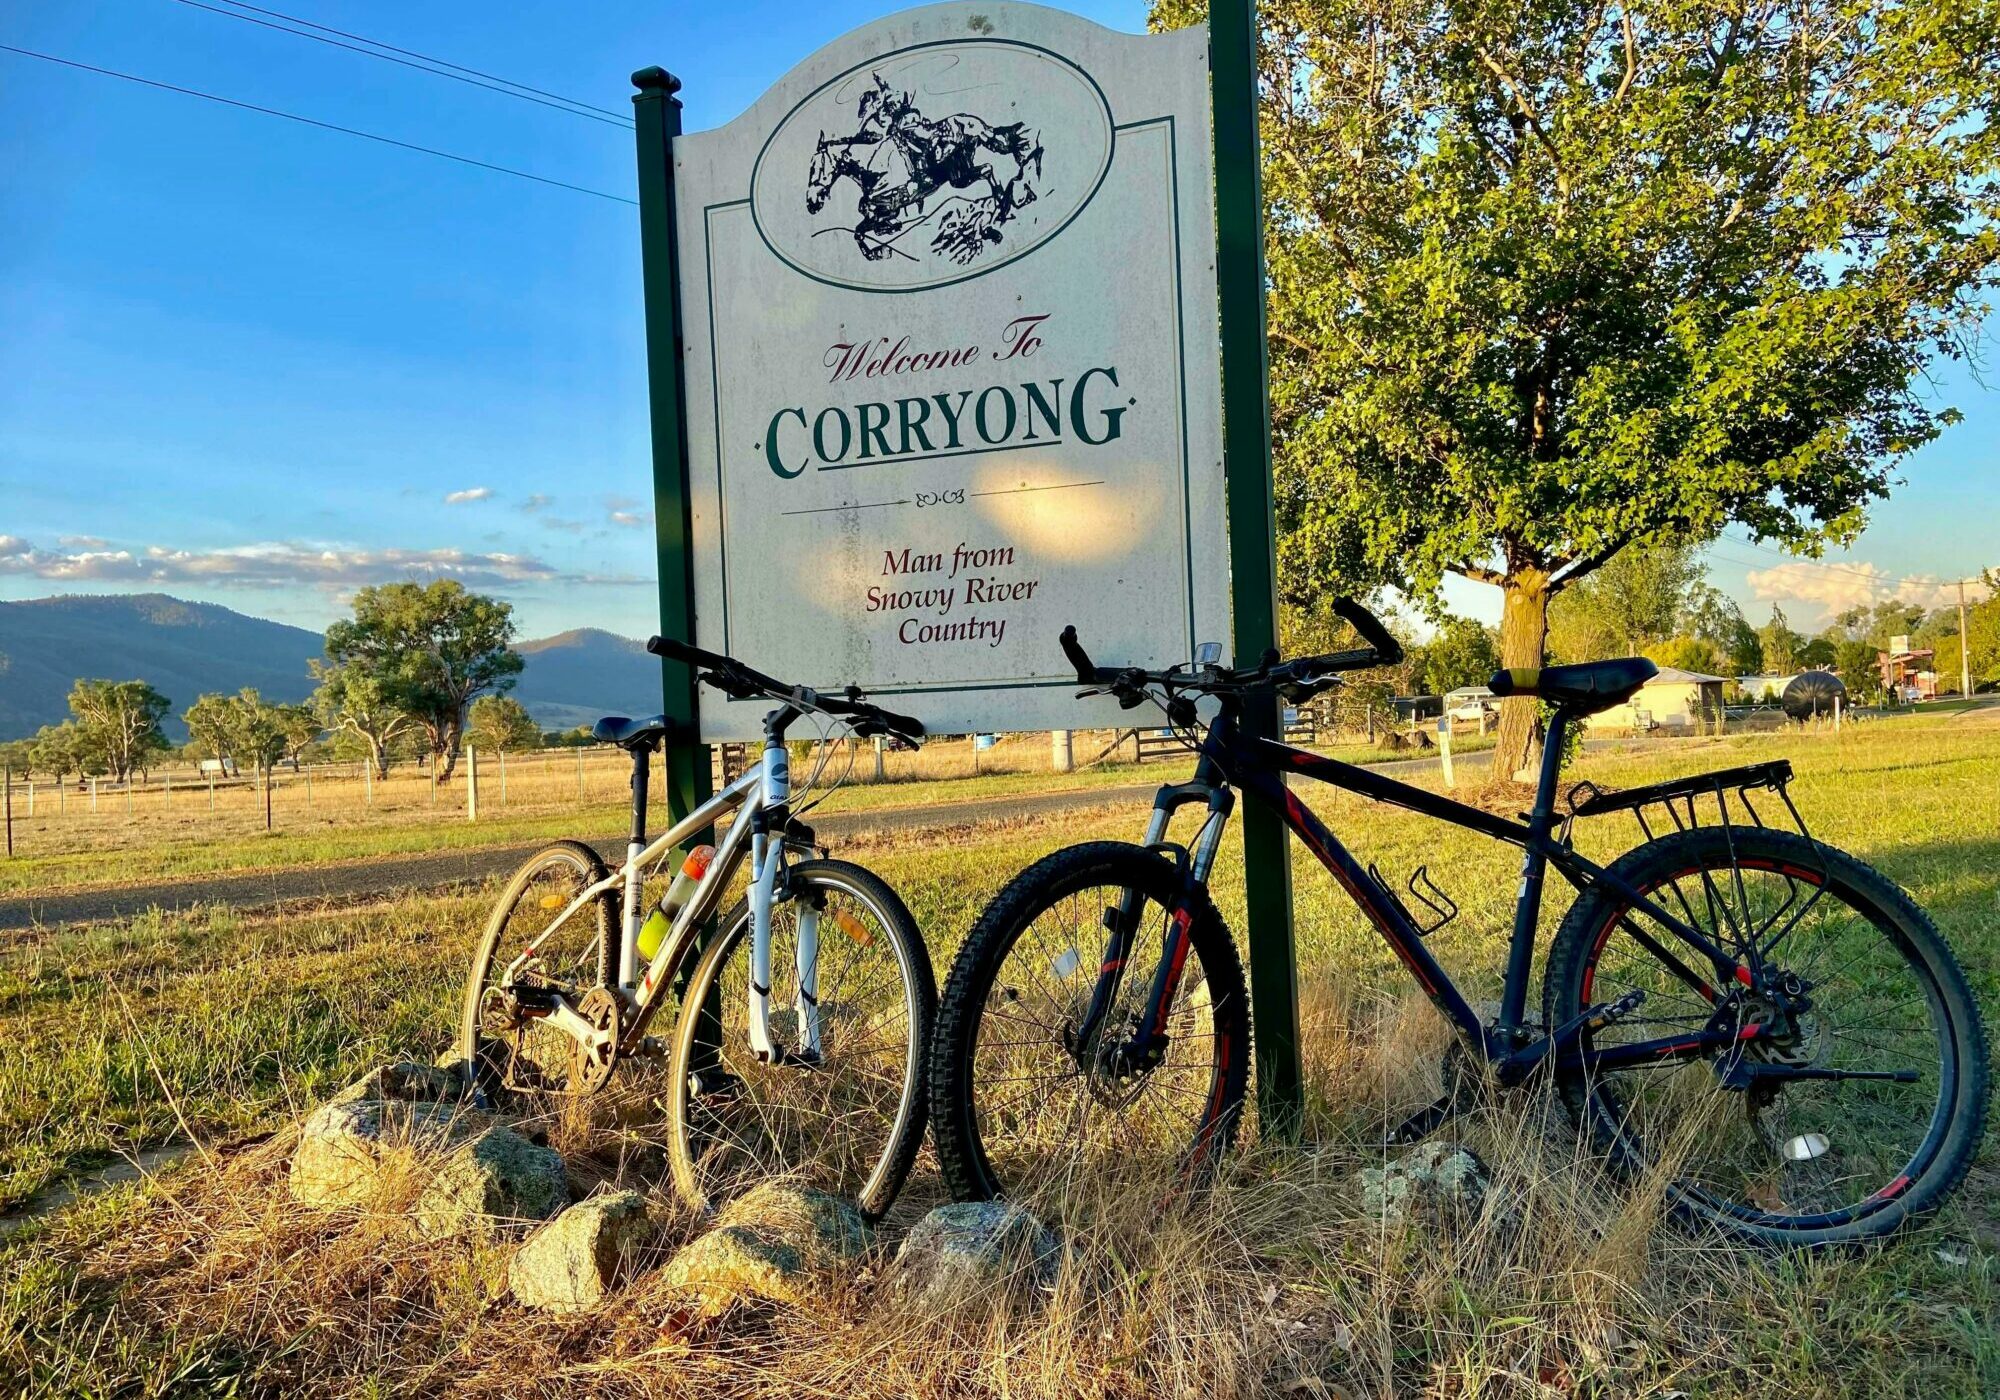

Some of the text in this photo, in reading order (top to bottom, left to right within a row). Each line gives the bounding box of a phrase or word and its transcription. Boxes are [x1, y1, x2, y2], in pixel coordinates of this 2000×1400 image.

[822, 313, 1052, 384] Welcome To
[765, 366, 1128, 480] CORRYONG
[882, 542, 1015, 579] Man from
[866, 576, 1039, 615] Snowy River
[898, 616, 1006, 649] Country
